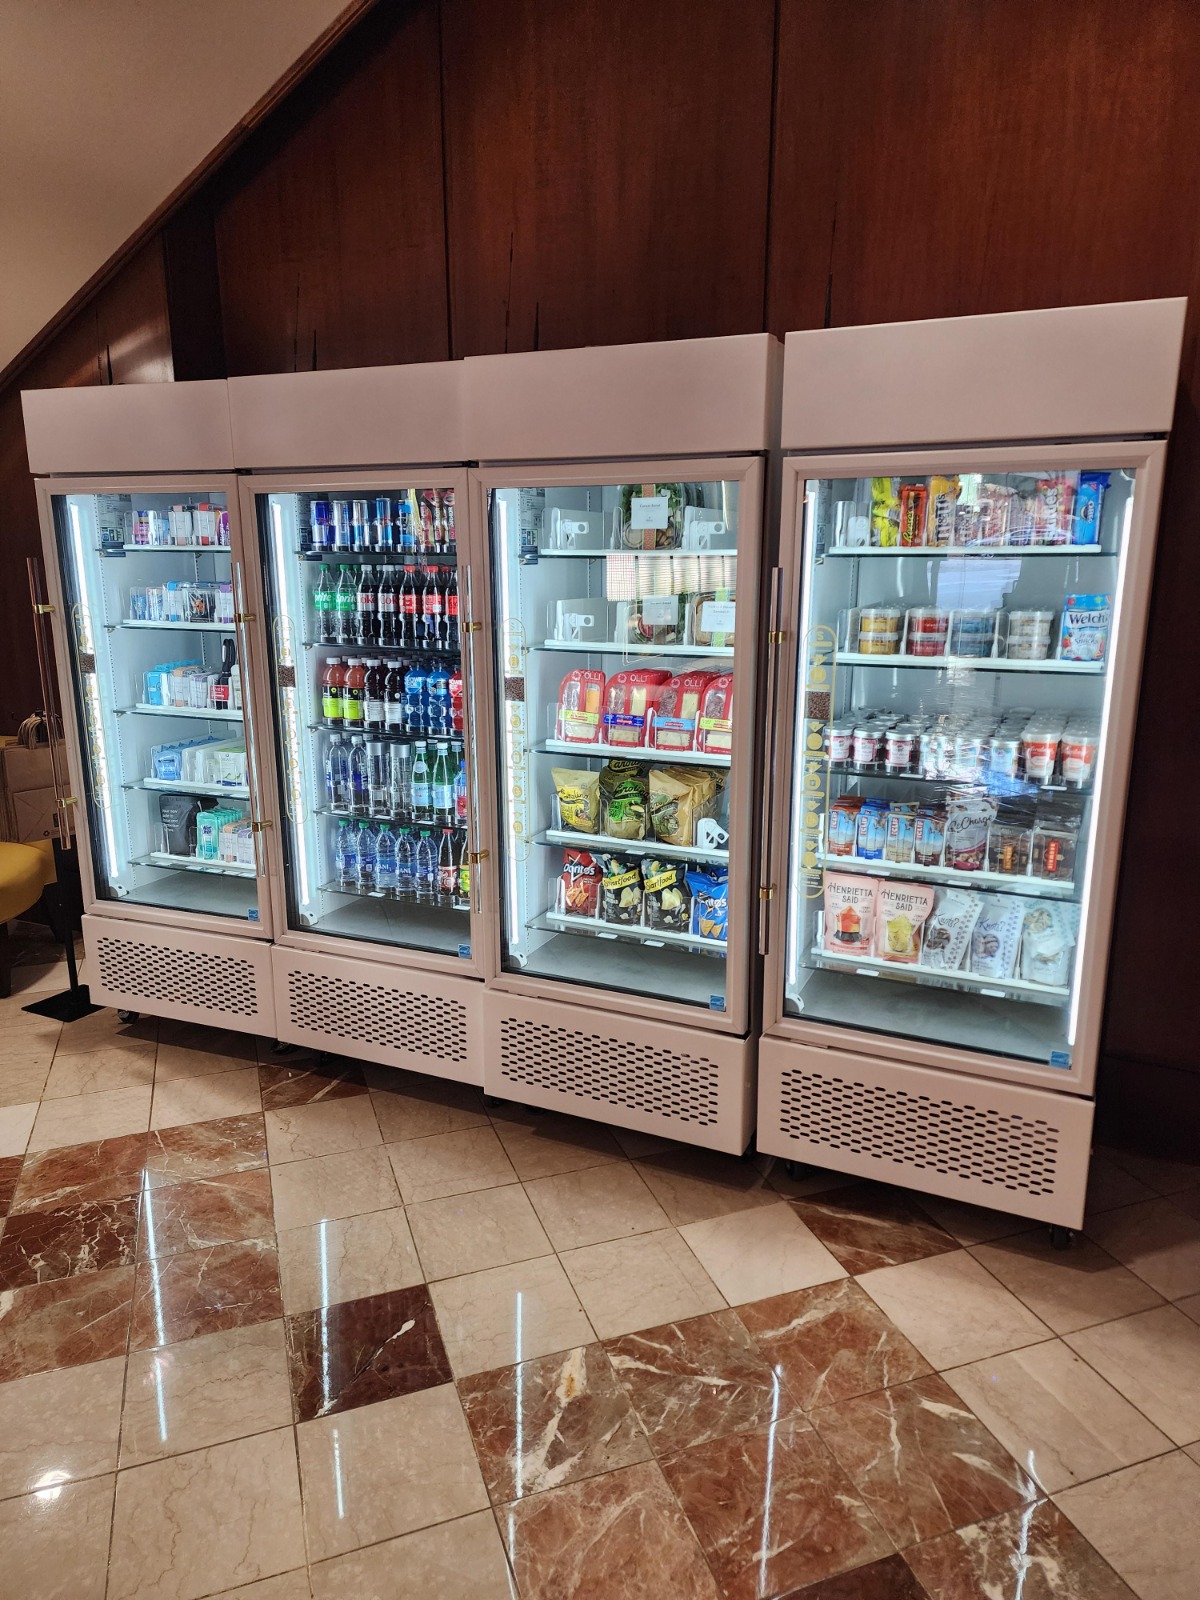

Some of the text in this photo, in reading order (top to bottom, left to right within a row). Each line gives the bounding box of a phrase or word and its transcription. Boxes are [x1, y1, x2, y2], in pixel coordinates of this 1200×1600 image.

[563, 863, 596, 876] Doritos
[827, 882, 873, 897] HENRIETTA
[842, 895, 859, 904] SAID
[881, 889, 928, 906] HENRIETTA
[895, 902, 913, 912] SAID
